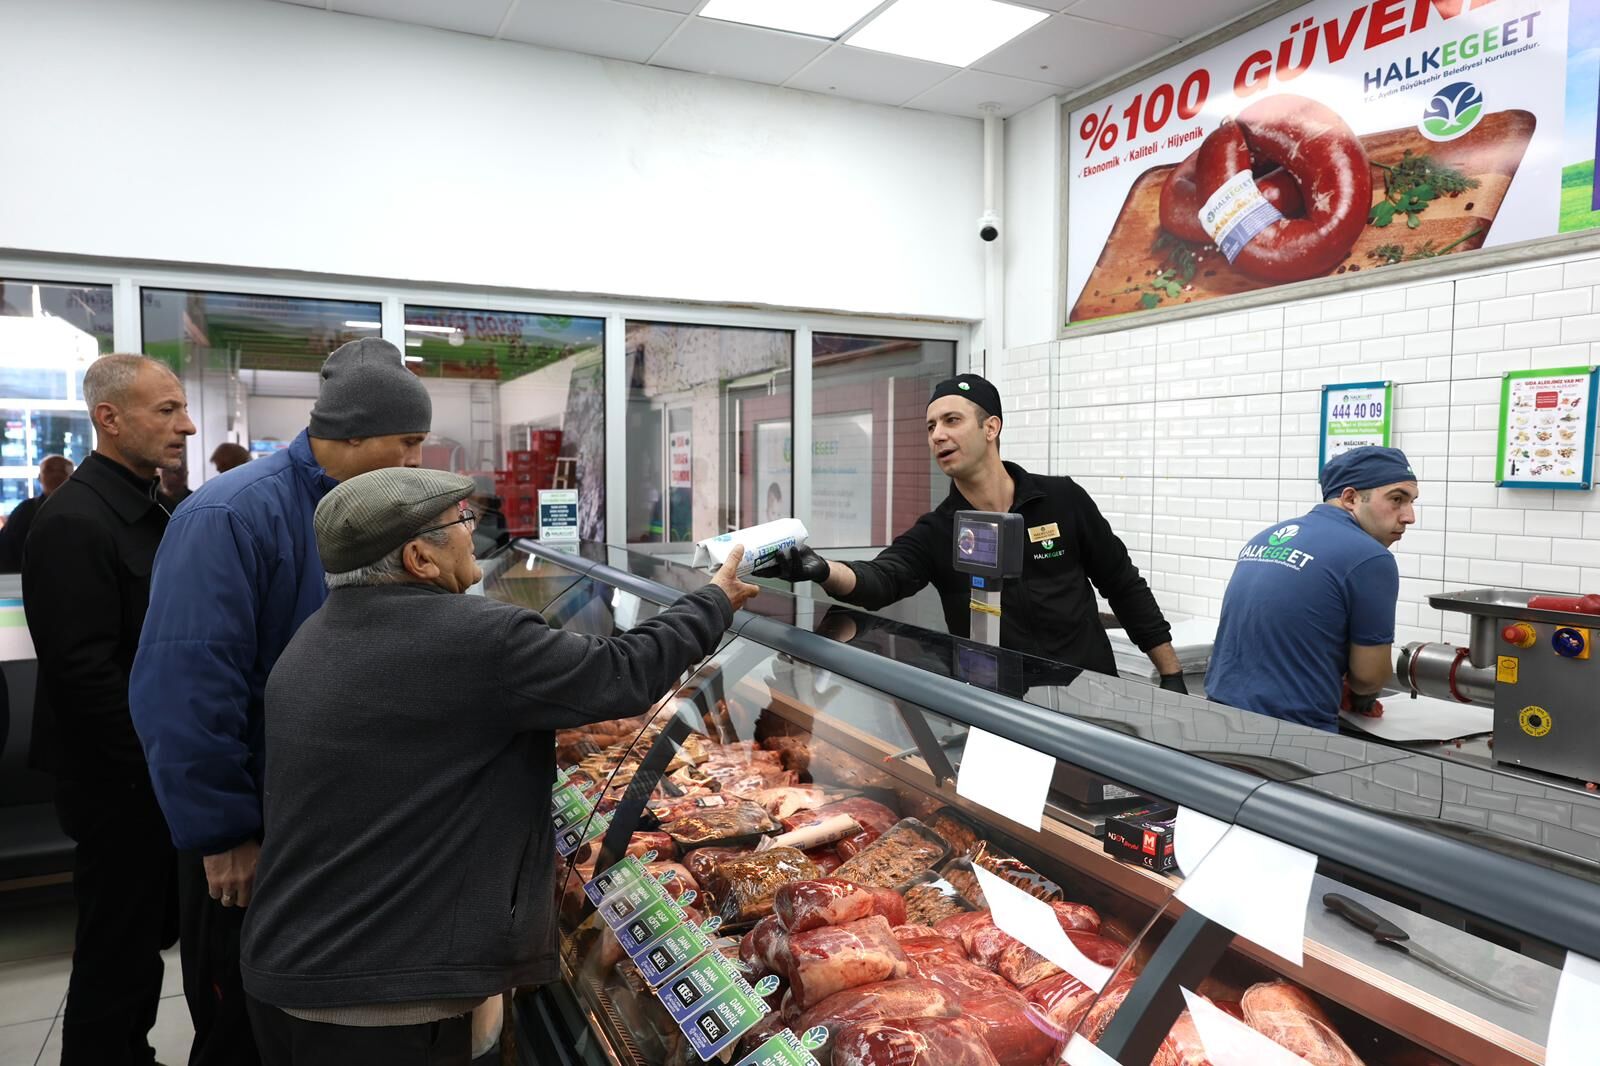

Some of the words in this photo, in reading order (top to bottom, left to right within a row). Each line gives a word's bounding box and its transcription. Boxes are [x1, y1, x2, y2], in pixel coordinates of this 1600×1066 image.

[1363, 11, 1541, 93] HALKEGEET
[1080, 69, 1210, 158] %100
[1233, 0, 1498, 97] GÜVEN
[1400, 74, 1441, 92] Büyükşehir
[1443, 60, 1483, 78] Belediyesi
[1485, 42, 1541, 64] Kuruluşudur.
[1083, 156, 1120, 178] Ekonomik
[1129, 142, 1158, 161] Kaliteli
[1167, 127, 1203, 149] Hijyenik
[1332, 404, 1351, 419] 444
[1354, 403, 1367, 418] 40
[1370, 402, 1382, 418] 09
[1144, 834, 1155, 847] M
[676, 935, 692, 950] DANA
[703, 966, 719, 983] DANA
[711, 949, 740, 979] HALKEGEET
[690, 969, 714, 994] ANTRİKOT
[729, 998, 746, 1017] DANA
[738, 977, 769, 1013] HALKEGEET
[702, 1017, 718, 1038] 1650
[717, 1002, 740, 1028] BONFİLE
